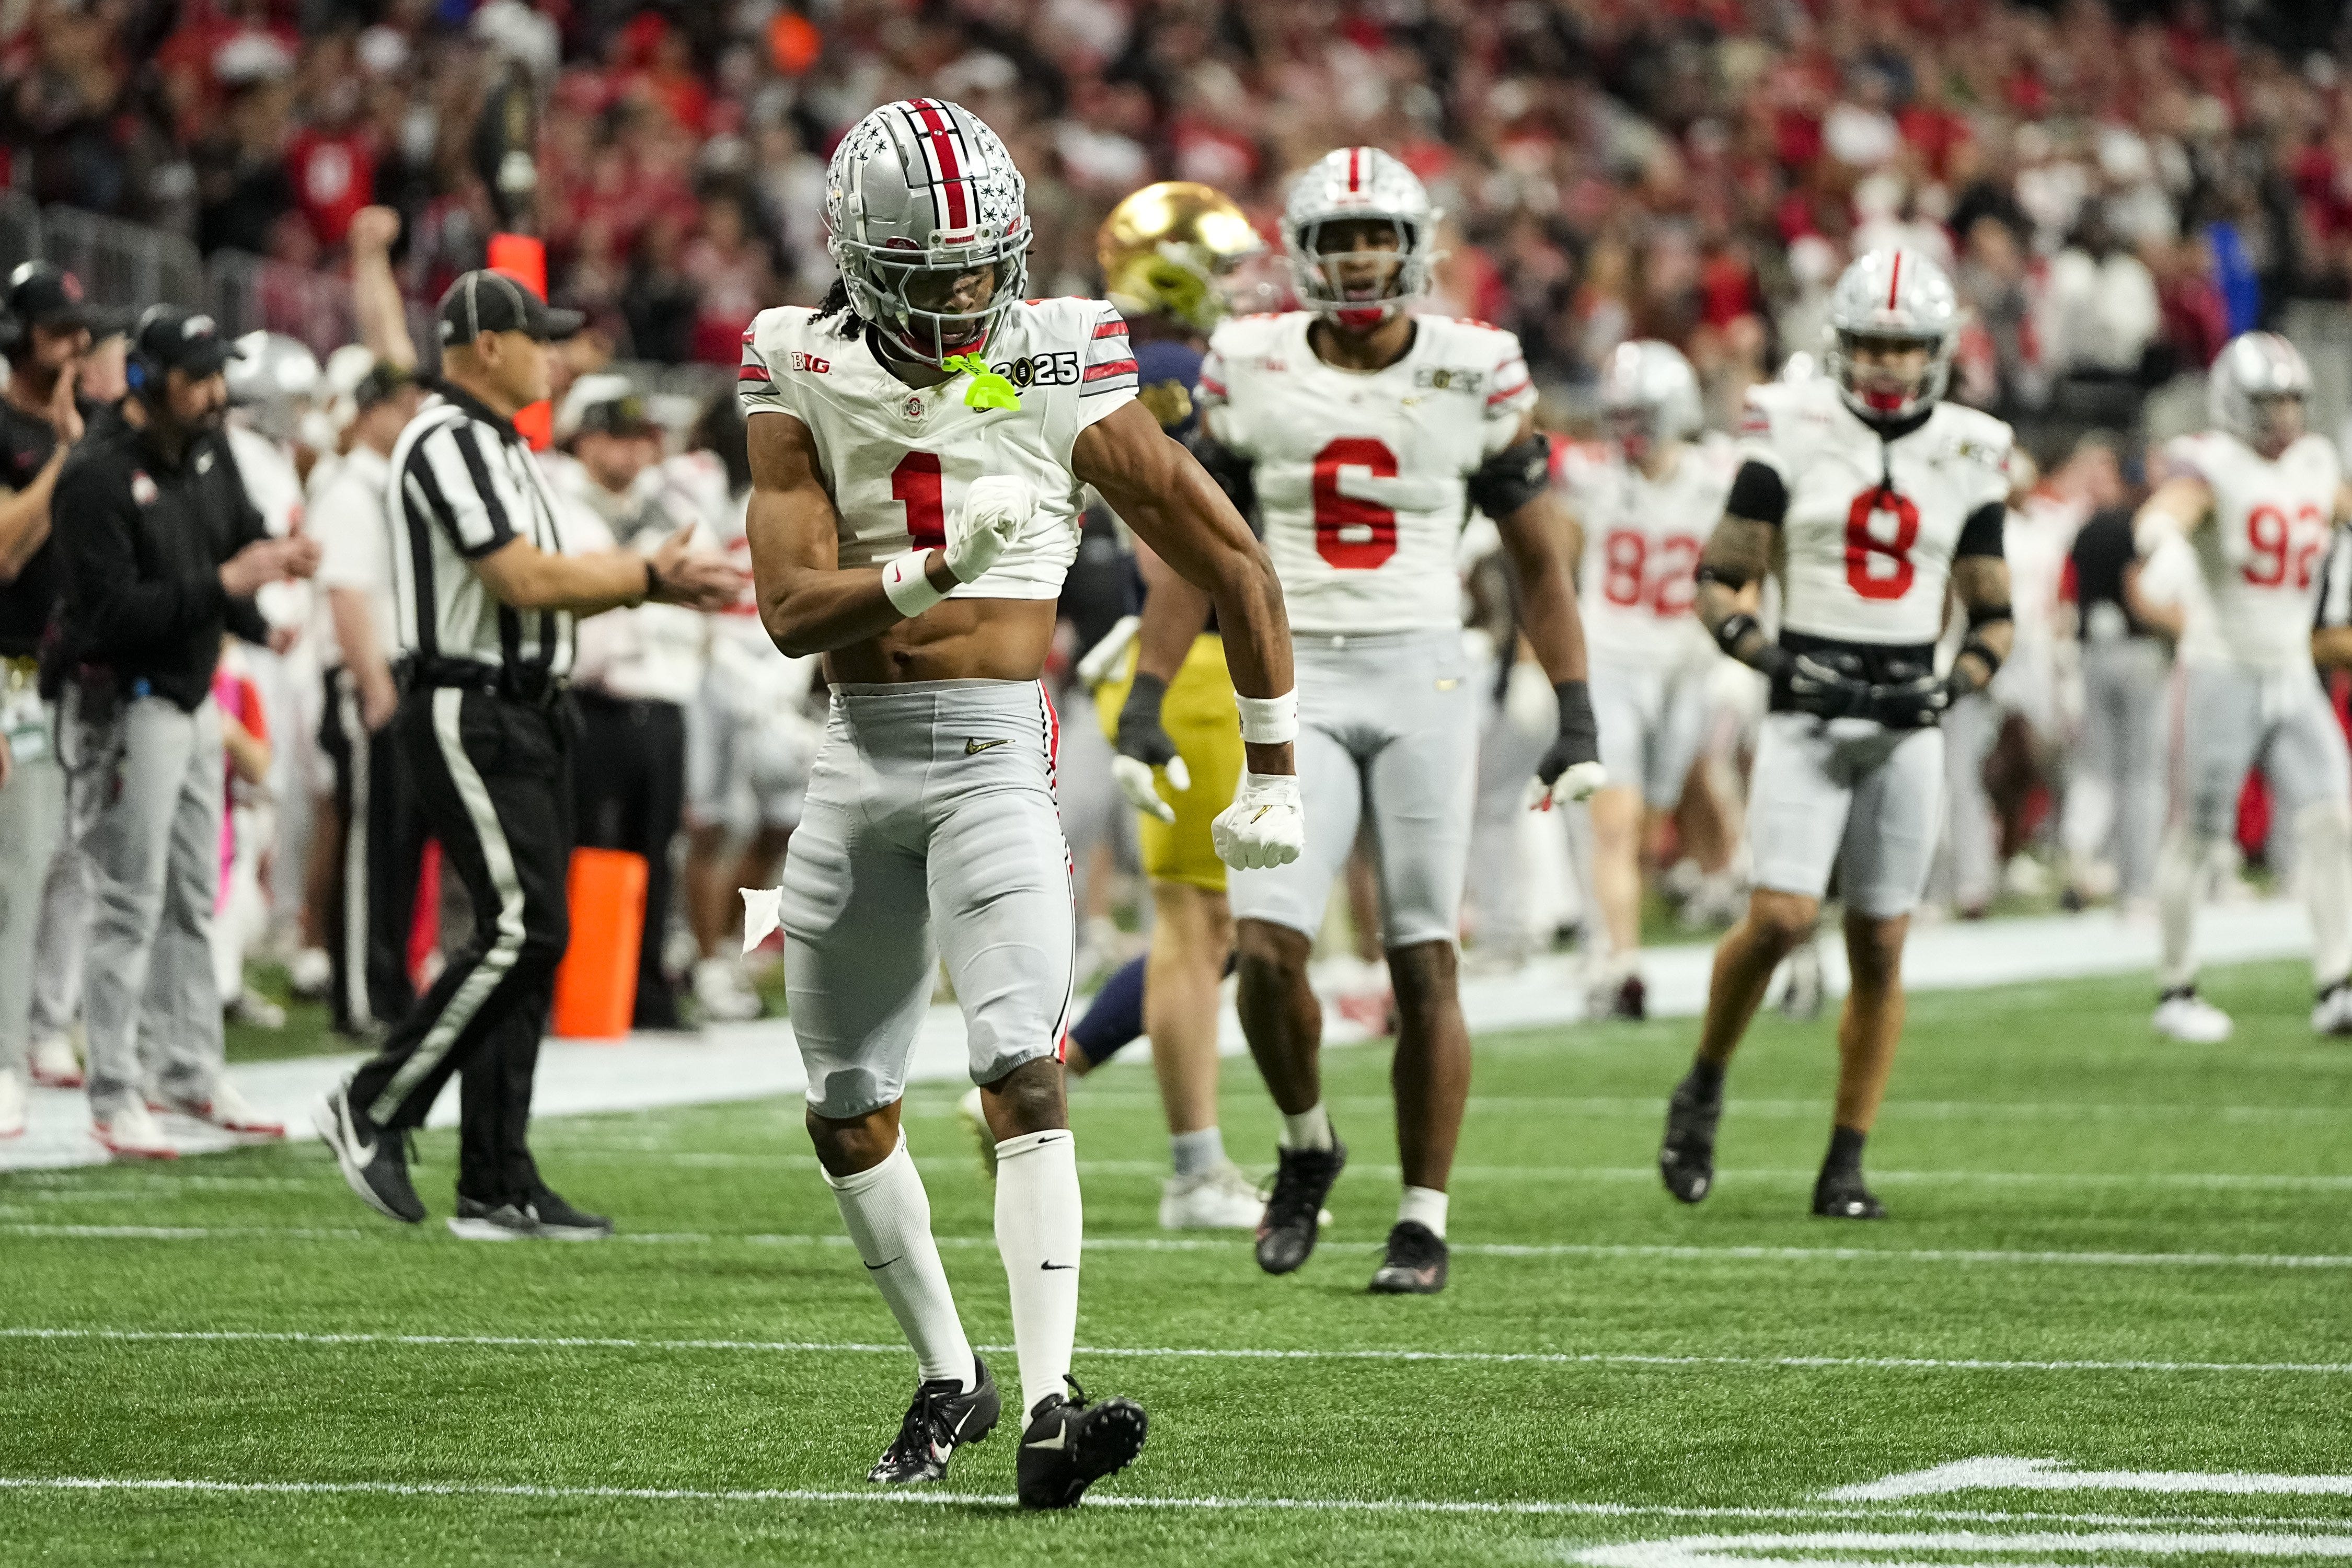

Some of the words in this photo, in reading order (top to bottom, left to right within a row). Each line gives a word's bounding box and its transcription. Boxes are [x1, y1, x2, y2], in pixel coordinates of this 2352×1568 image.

[891, 451, 947, 552] 1
[1312, 435, 1399, 570] 6
[1846, 485, 1920, 600] 8
[2240, 503, 2323, 591] 92
[1605, 531, 1703, 618] 82
